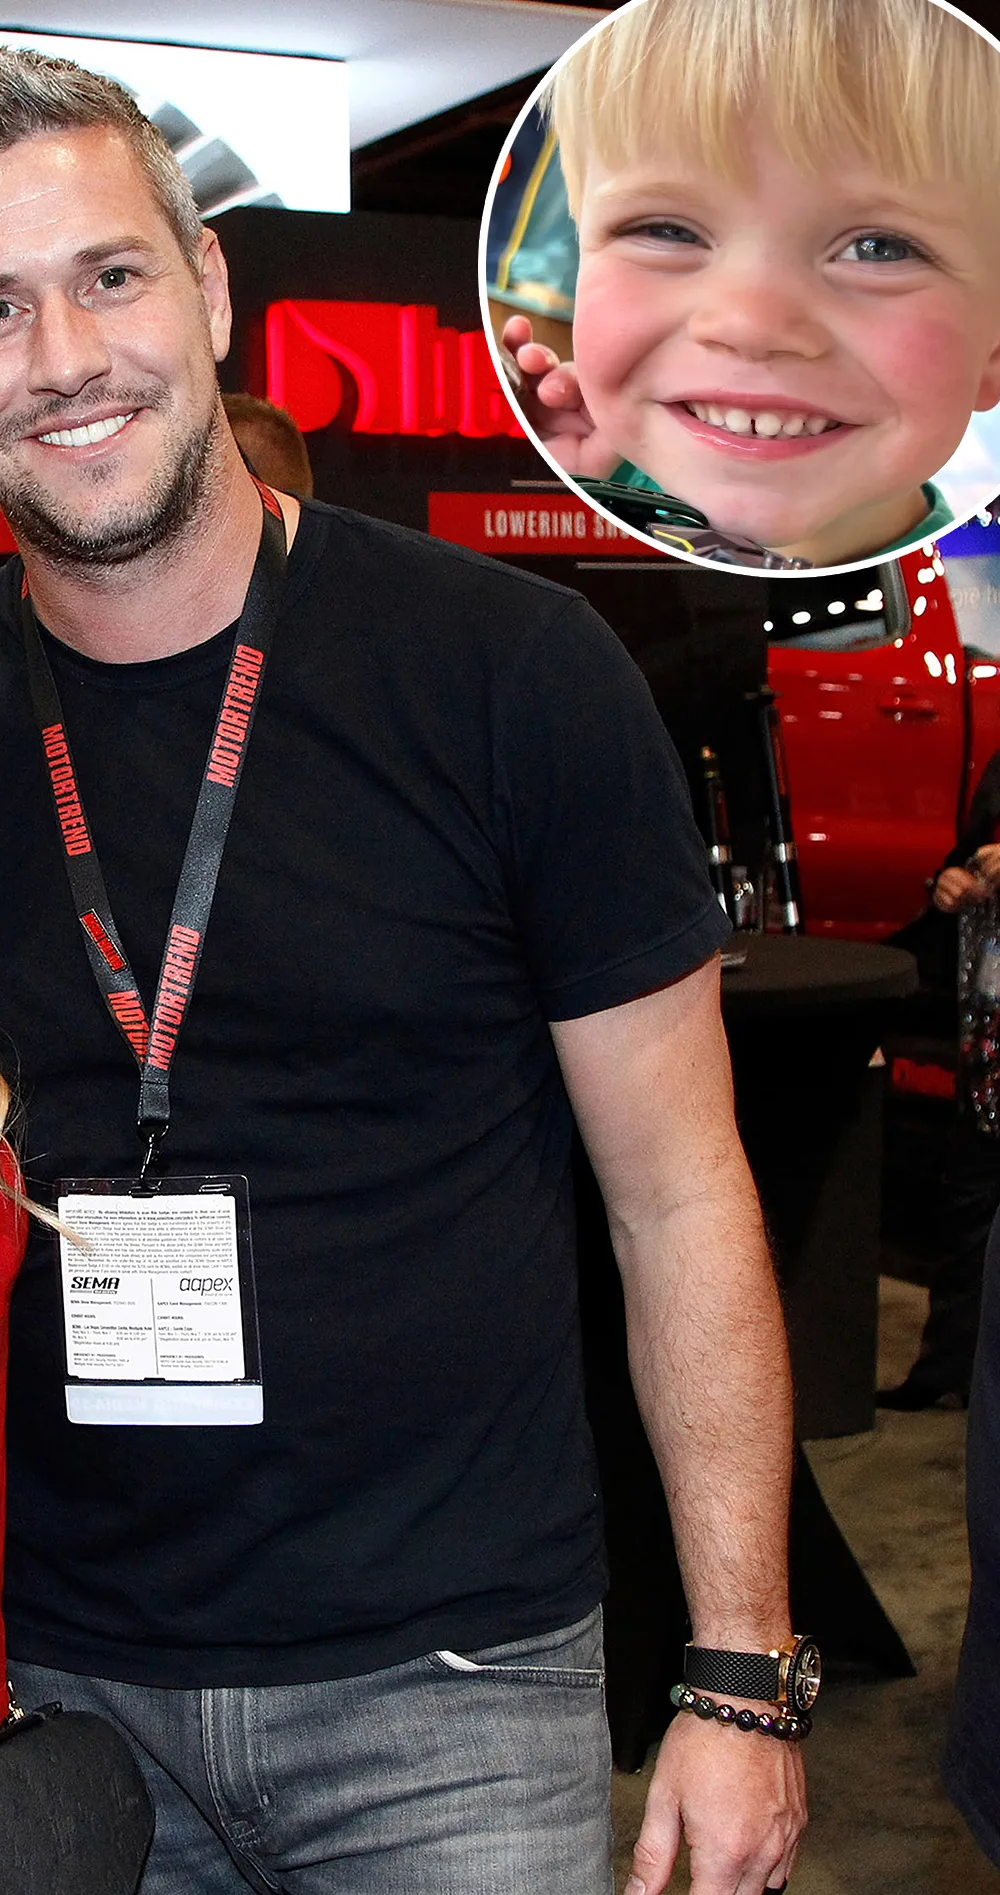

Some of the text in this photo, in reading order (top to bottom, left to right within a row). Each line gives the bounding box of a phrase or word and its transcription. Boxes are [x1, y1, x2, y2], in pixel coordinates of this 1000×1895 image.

[484, 510, 587, 538] LOWERING
[206, 643, 264, 788] MOTORTREND
[42, 723, 92, 856] MOTORTREND
[148, 924, 200, 1070] MOTORTREND
[71, 1276, 120, 1290] SEMA
[179, 1277, 234, 1297] aapex
